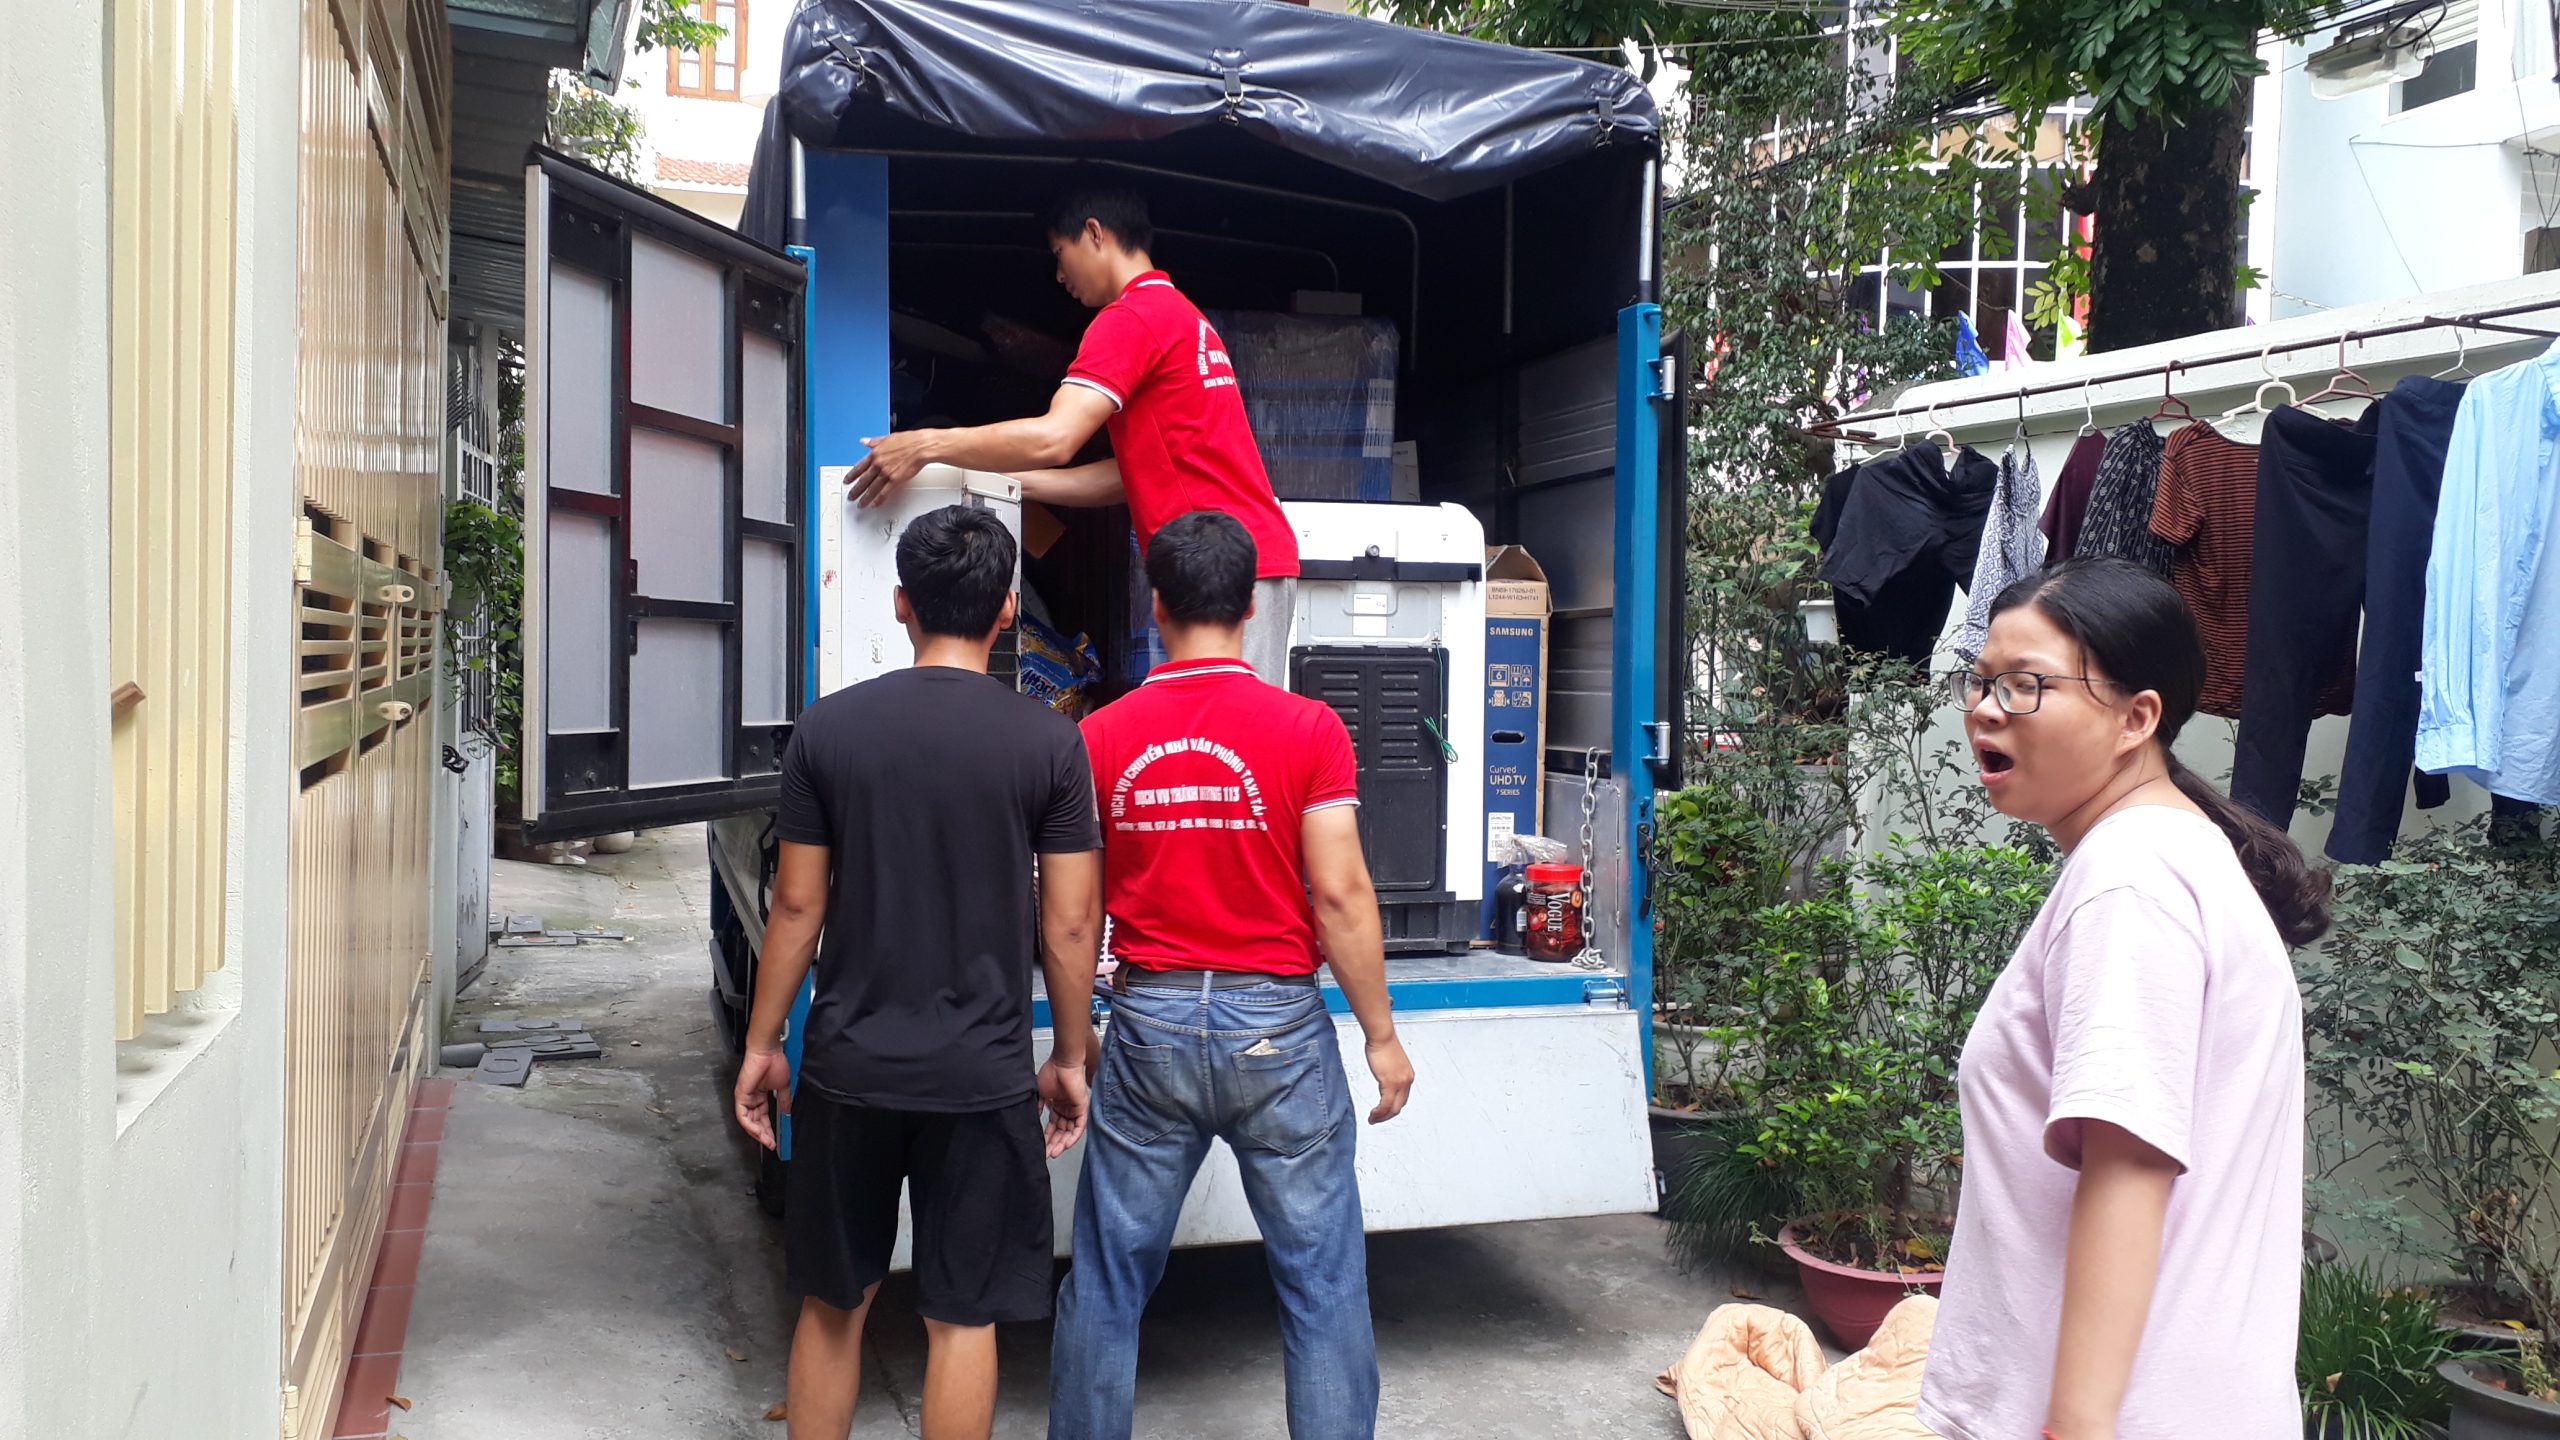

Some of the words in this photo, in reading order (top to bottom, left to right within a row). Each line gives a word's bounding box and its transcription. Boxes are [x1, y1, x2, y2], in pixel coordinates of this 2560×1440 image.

[1489, 626, 1535, 637] SAMSUNG
[1495, 671, 1503, 680] 6
[1190, 737, 1212, 754] VĂN
[1123, 743, 1165, 779] CHUYỂN
[1210, 743, 1246, 773] PHÒNG
[1489, 765, 1517, 774] Curved
[1114, 777, 1133, 792] VỤ
[1240, 769, 1259, 797] TAXI
[1489, 775, 1513, 786] UHD
[1513, 775, 1527, 786] TV
[1111, 794, 1126, 817] DỊCH
[1546, 892, 1570, 932] VOGUE
